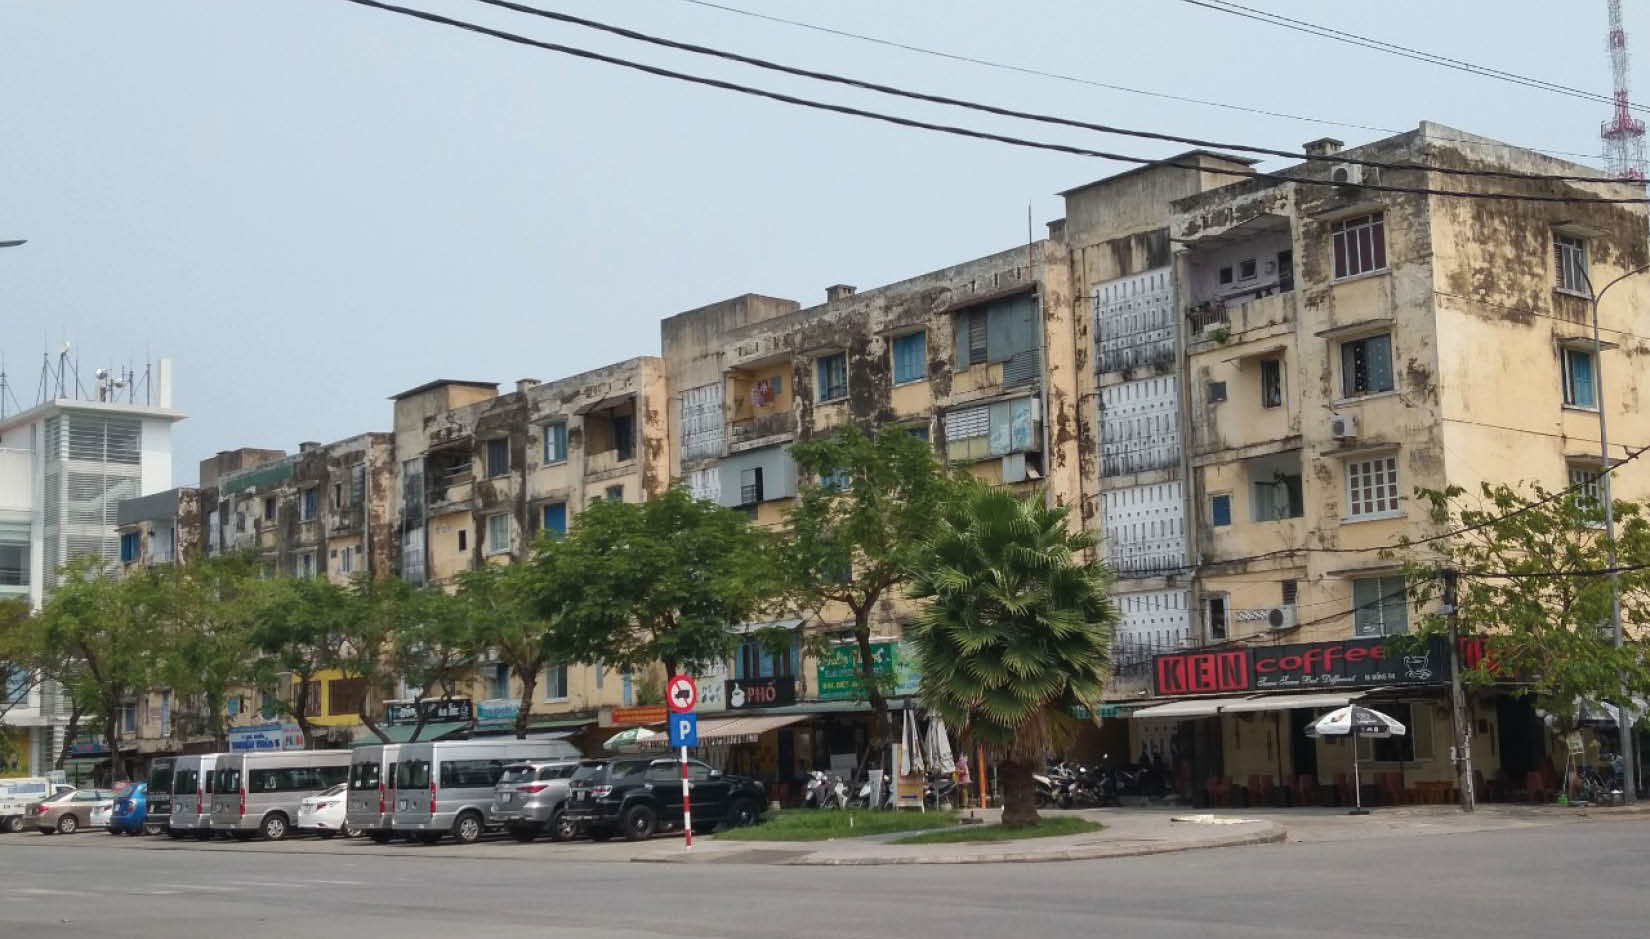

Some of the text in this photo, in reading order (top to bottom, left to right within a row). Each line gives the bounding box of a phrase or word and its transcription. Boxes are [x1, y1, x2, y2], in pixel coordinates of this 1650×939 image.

[1159, 645, 1384, 692] KEN coffee
[680, 720, 691, 740] P
